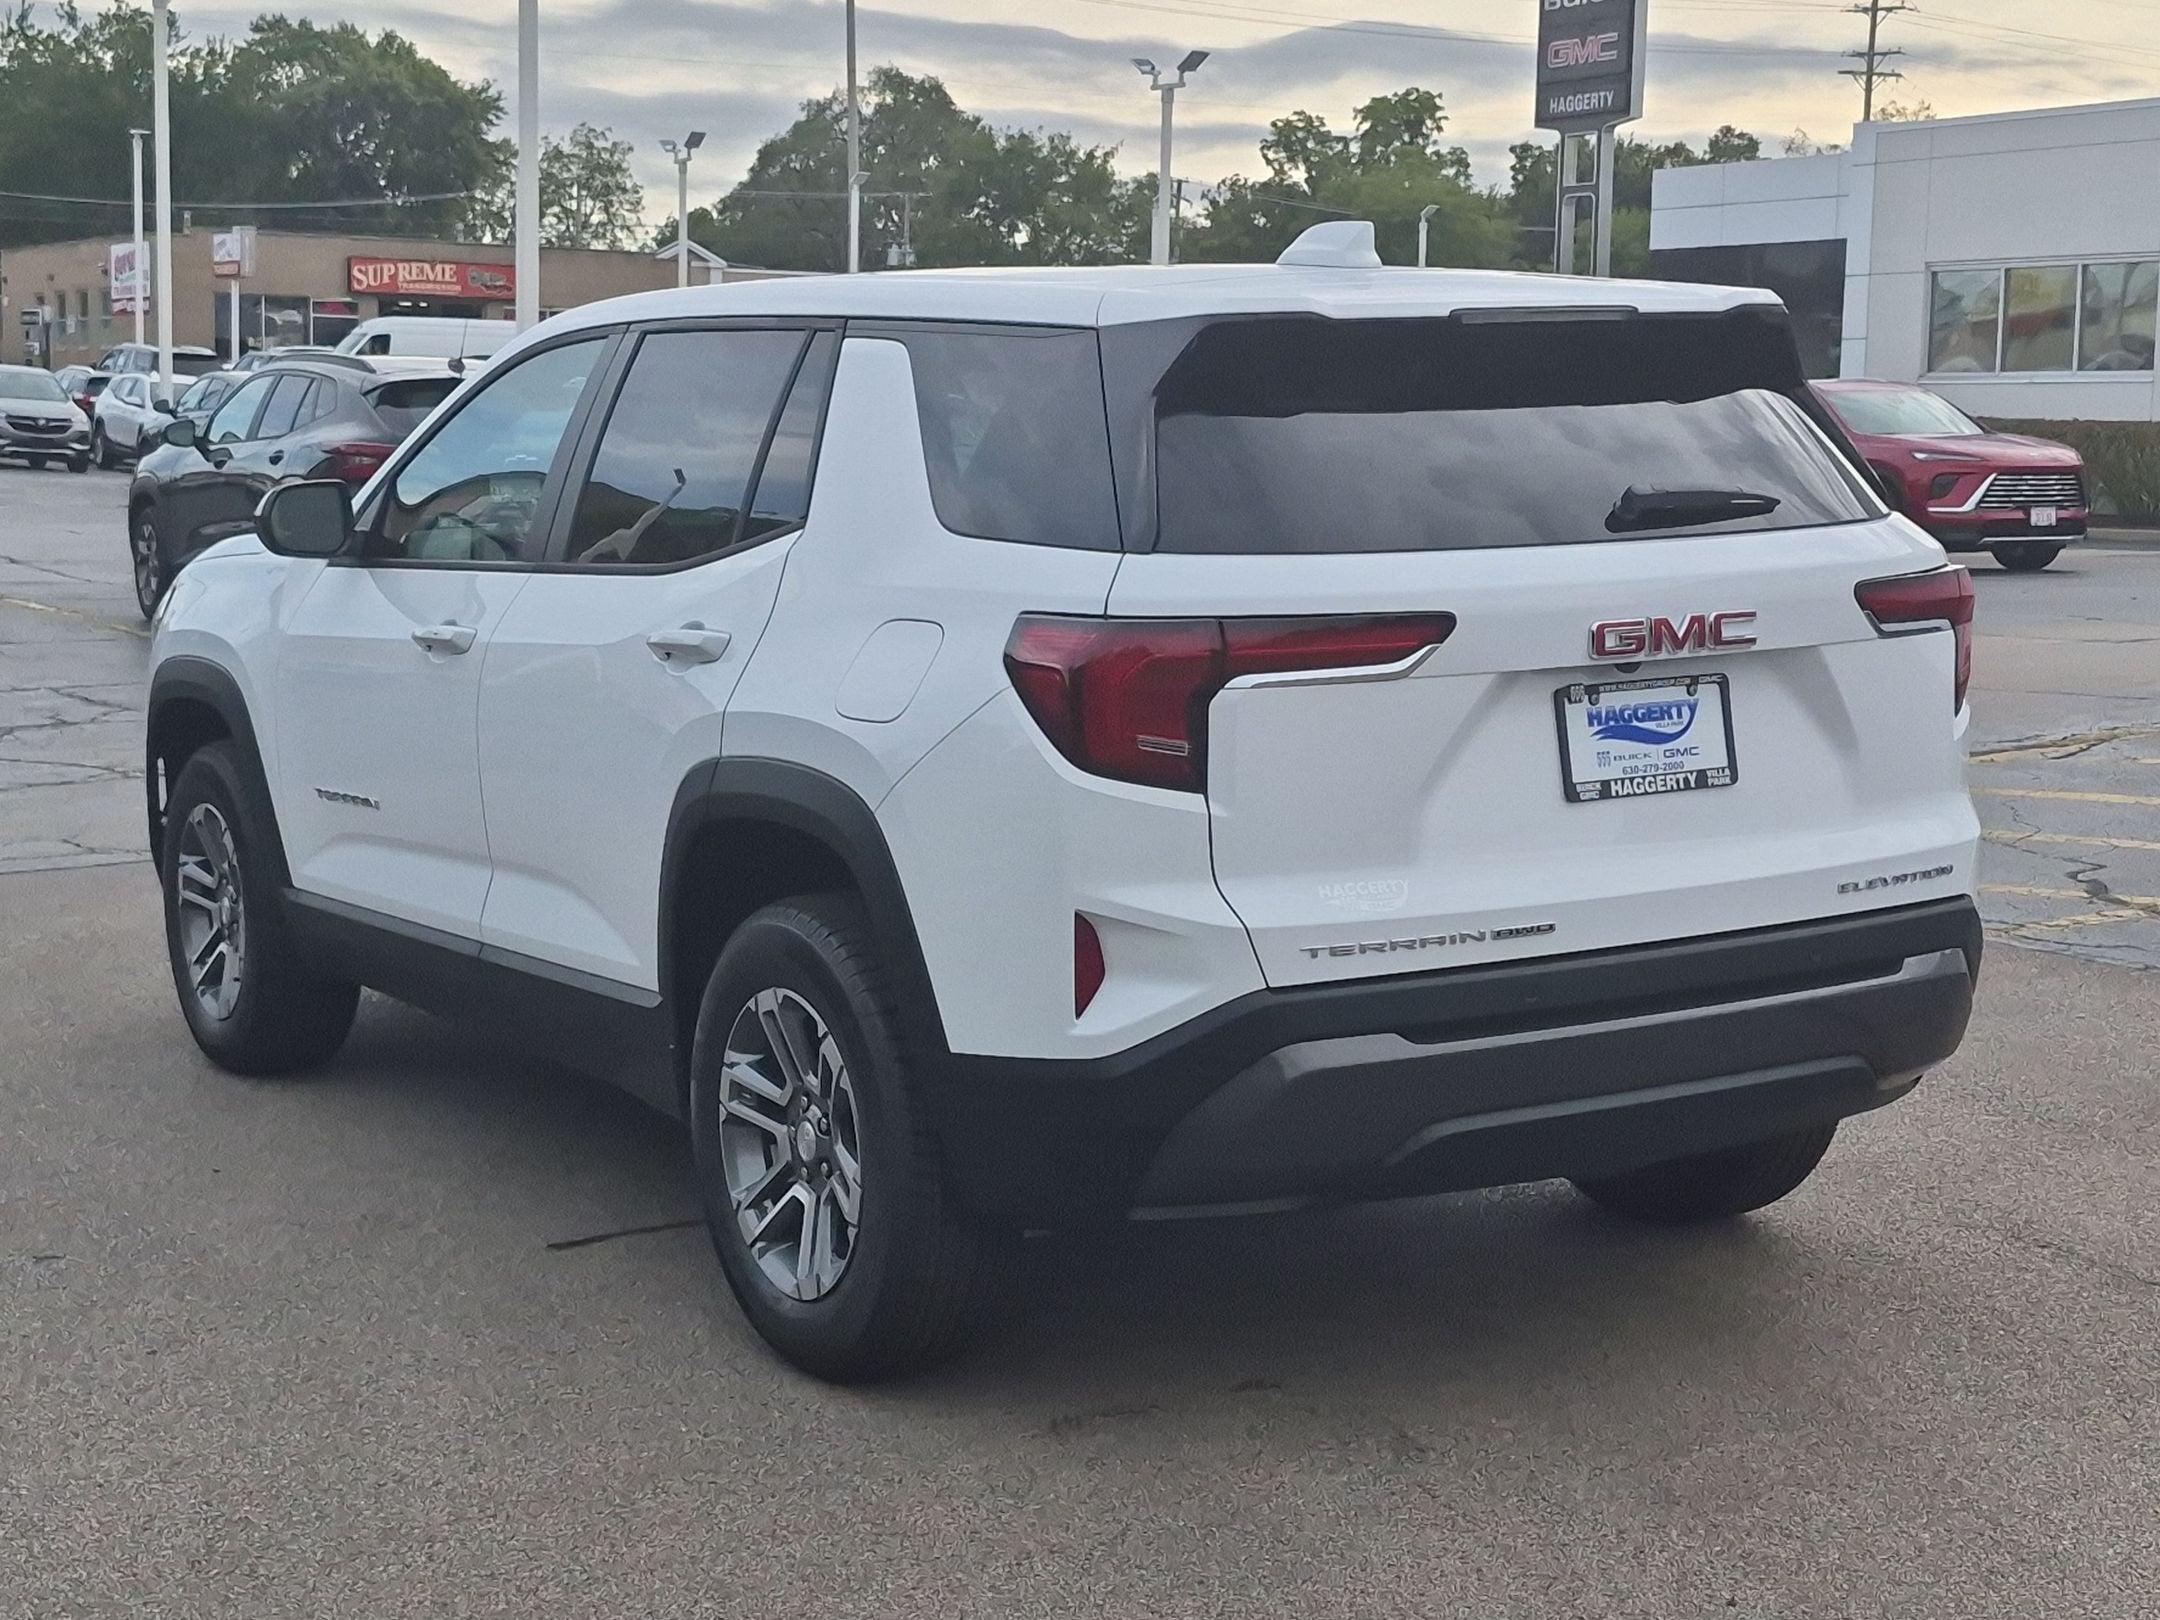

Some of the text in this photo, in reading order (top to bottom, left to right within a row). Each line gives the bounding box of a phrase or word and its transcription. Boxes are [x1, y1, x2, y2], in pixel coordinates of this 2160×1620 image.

[1547, 33, 1618, 68] GMC
[1549, 91, 1614, 114] HAGGERTY
[352, 262, 457, 290] SUPREME
[1588, 610, 1757, 659] GMC
[1586, 699, 1699, 727] HAGGERTY
[1613, 747, 1700, 762] BUICK GMC
[1610, 772, 1698, 796] HAGGERTY
[1706, 768, 1731, 778] VILLA
[1707, 777, 1732, 786] PARK
[1838, 865, 1954, 894] ELEVATION
[1299, 928, 1486, 959] TERRAIN
